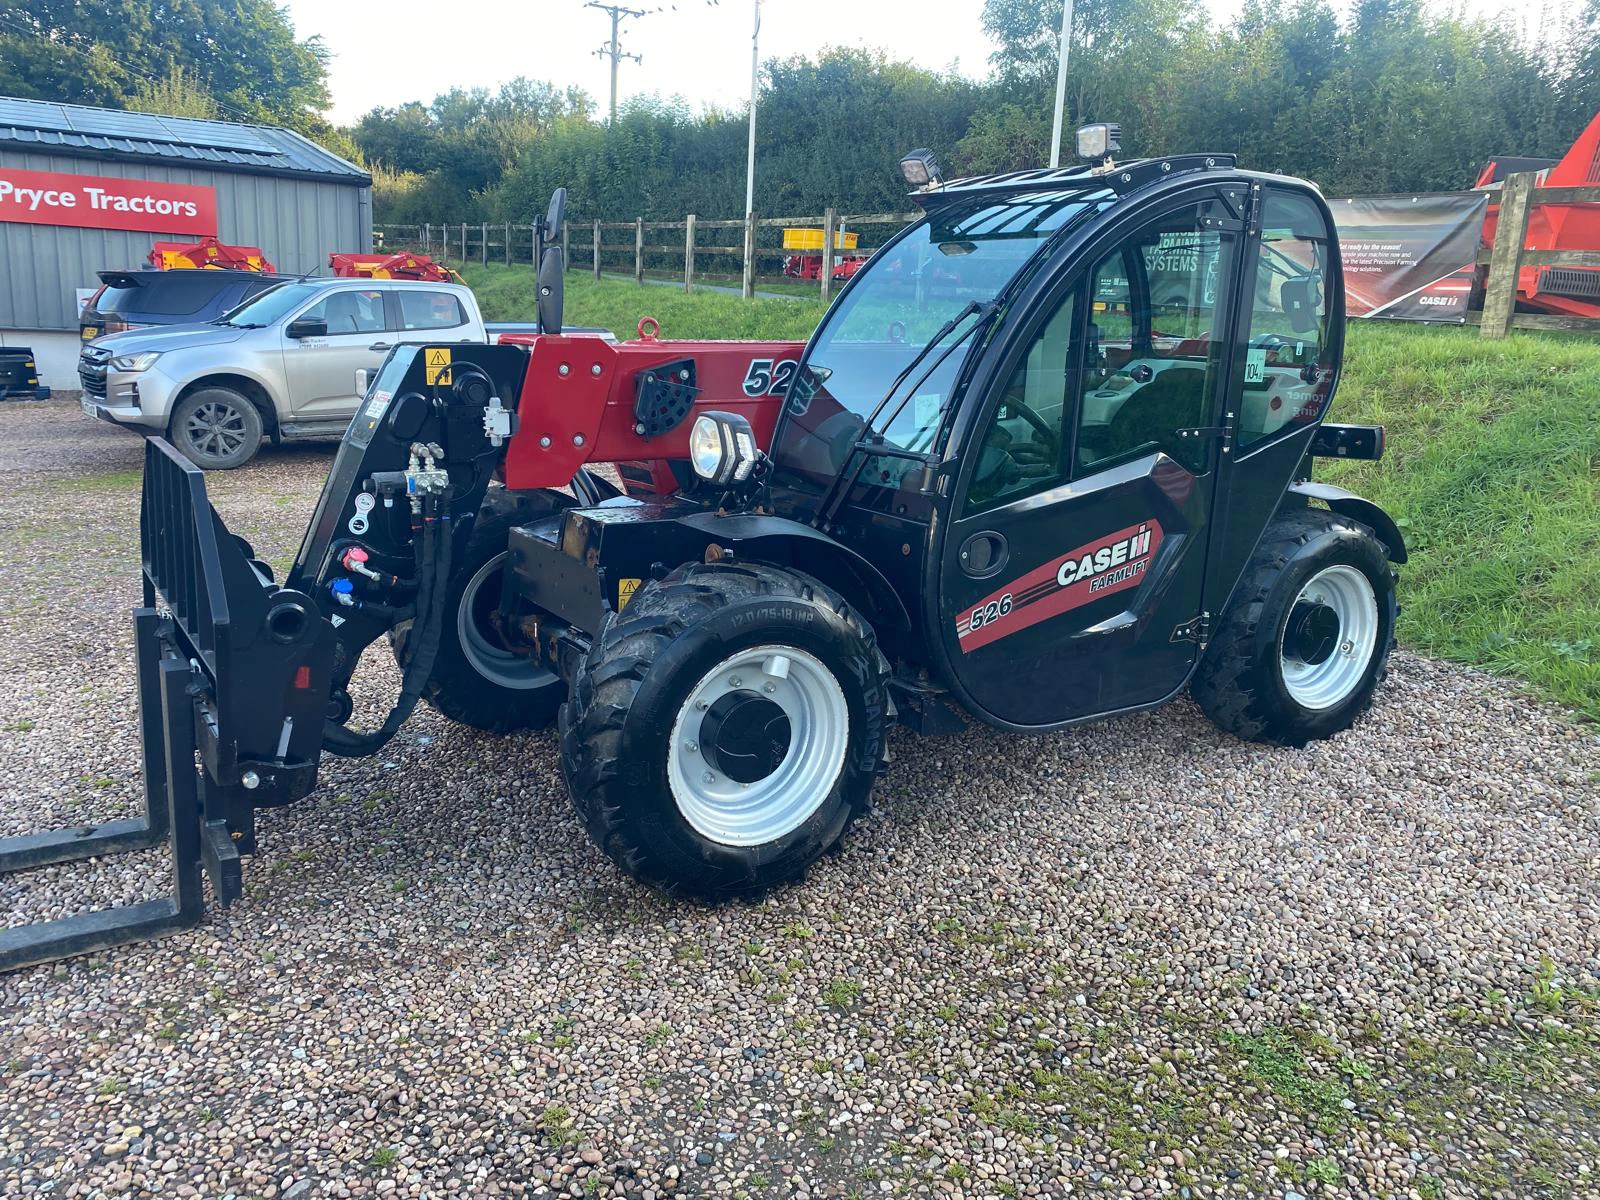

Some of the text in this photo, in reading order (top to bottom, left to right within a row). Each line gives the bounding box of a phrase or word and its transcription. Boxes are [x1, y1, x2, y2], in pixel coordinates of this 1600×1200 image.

[0, 180, 198, 217] Pryce Tractors
[1145, 255, 1198, 272] SYSTEMS
[1347, 243, 1362, 251] ready
[1419, 296, 1448, 306] CASE
[742, 358, 799, 397] 52
[1056, 538, 1129, 588] CASE
[1088, 556, 1151, 594] FARMLIFT
[968, 592, 1013, 632] 526
